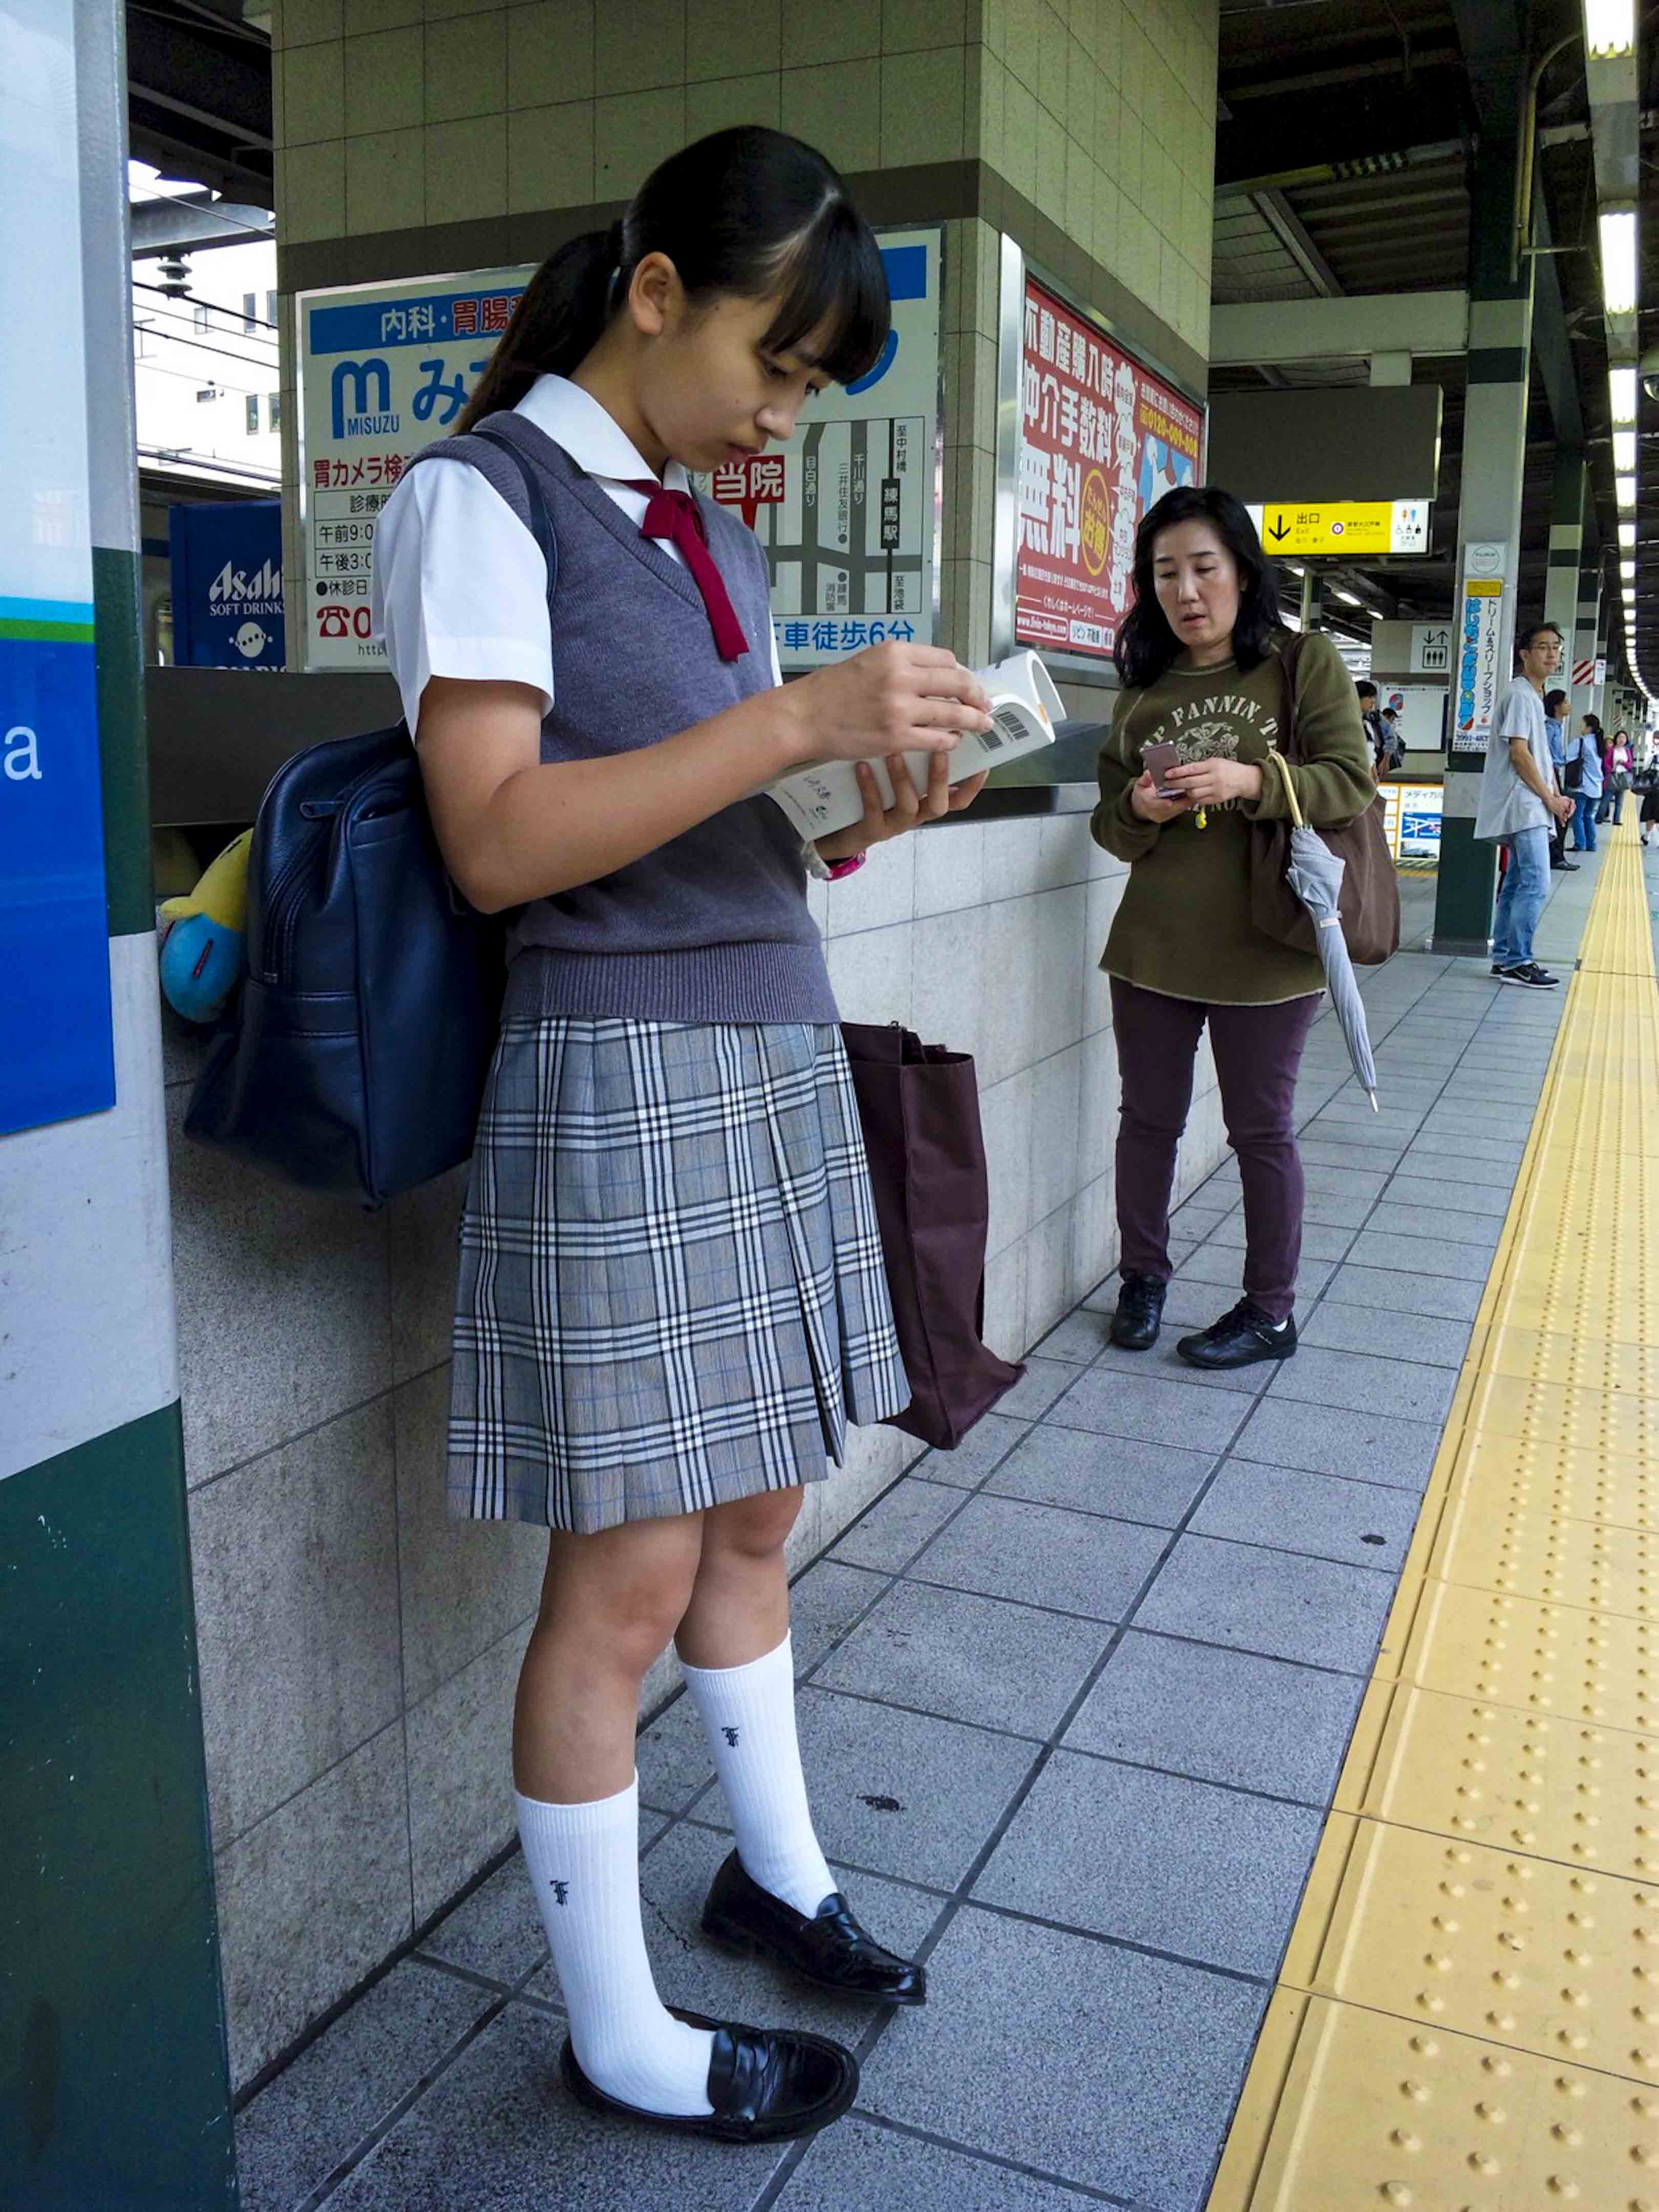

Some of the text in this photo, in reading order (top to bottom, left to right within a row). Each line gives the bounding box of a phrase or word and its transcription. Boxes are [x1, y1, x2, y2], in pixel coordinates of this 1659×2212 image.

[1025, 296, 1114, 402] 不動産購入時
[348, 415, 400, 435] MISUZU
[314, 453, 411, 488] 胃カメラ検
[896, 425, 907, 473] 至中村橋
[716, 460, 783, 499] 当院
[805, 455, 817, 507] 目白通り
[838, 462, 849, 533] 三井住友銀行
[853, 454, 865, 505] 千川通り
[1018, 434, 1081, 565] 無料
[884, 487, 898, 541] 練馬駅
[1296, 513, 1320, 524] 出口
[209, 558, 285, 602] Asah
[894, 575, 905, 611] 至池袋
[209, 603, 240, 616] SOFT
[1171, 695, 1262, 728] FANNIN,
